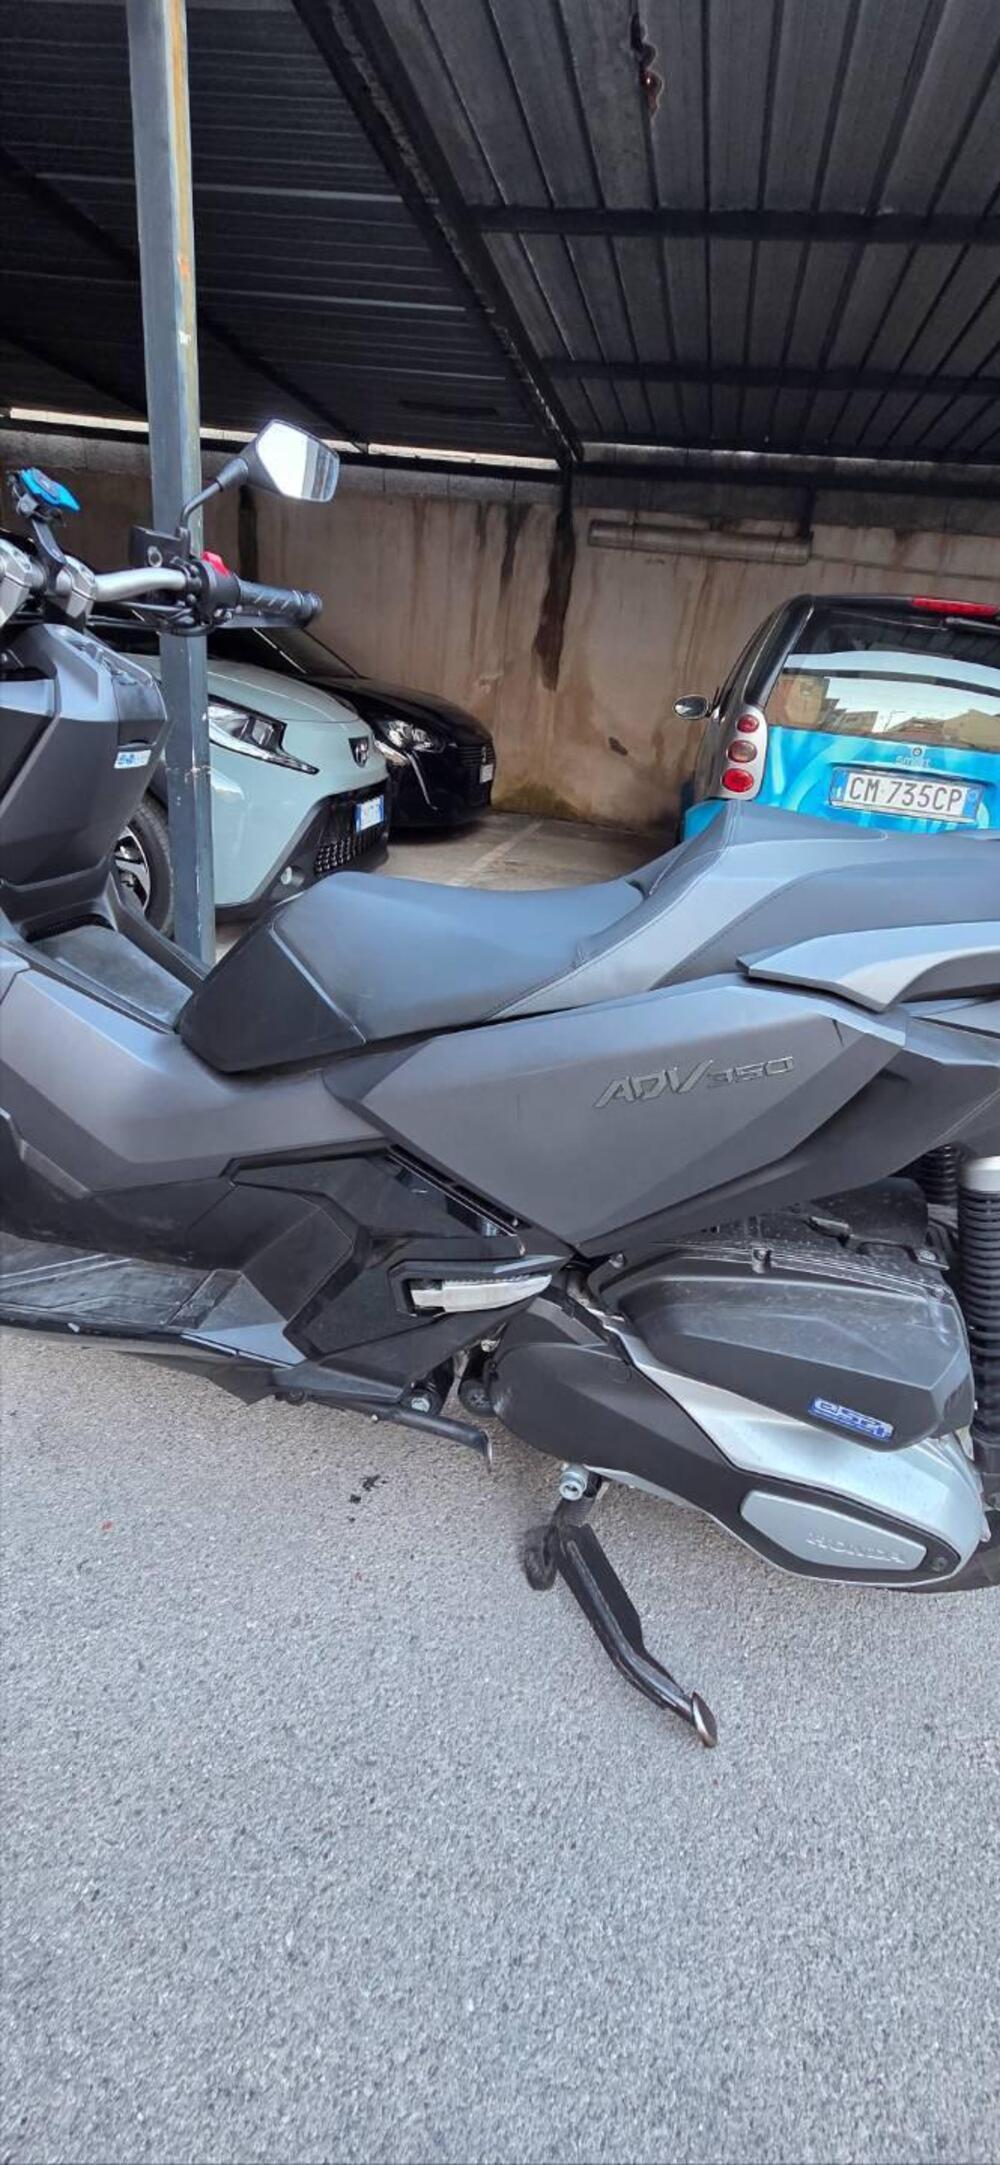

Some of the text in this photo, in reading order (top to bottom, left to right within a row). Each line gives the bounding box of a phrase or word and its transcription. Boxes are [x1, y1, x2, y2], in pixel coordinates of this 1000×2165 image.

[849, 777, 963, 813] CM 735CP
[593, 1055, 794, 1107] ADV 350
[805, 1529, 906, 1565] HONDA
